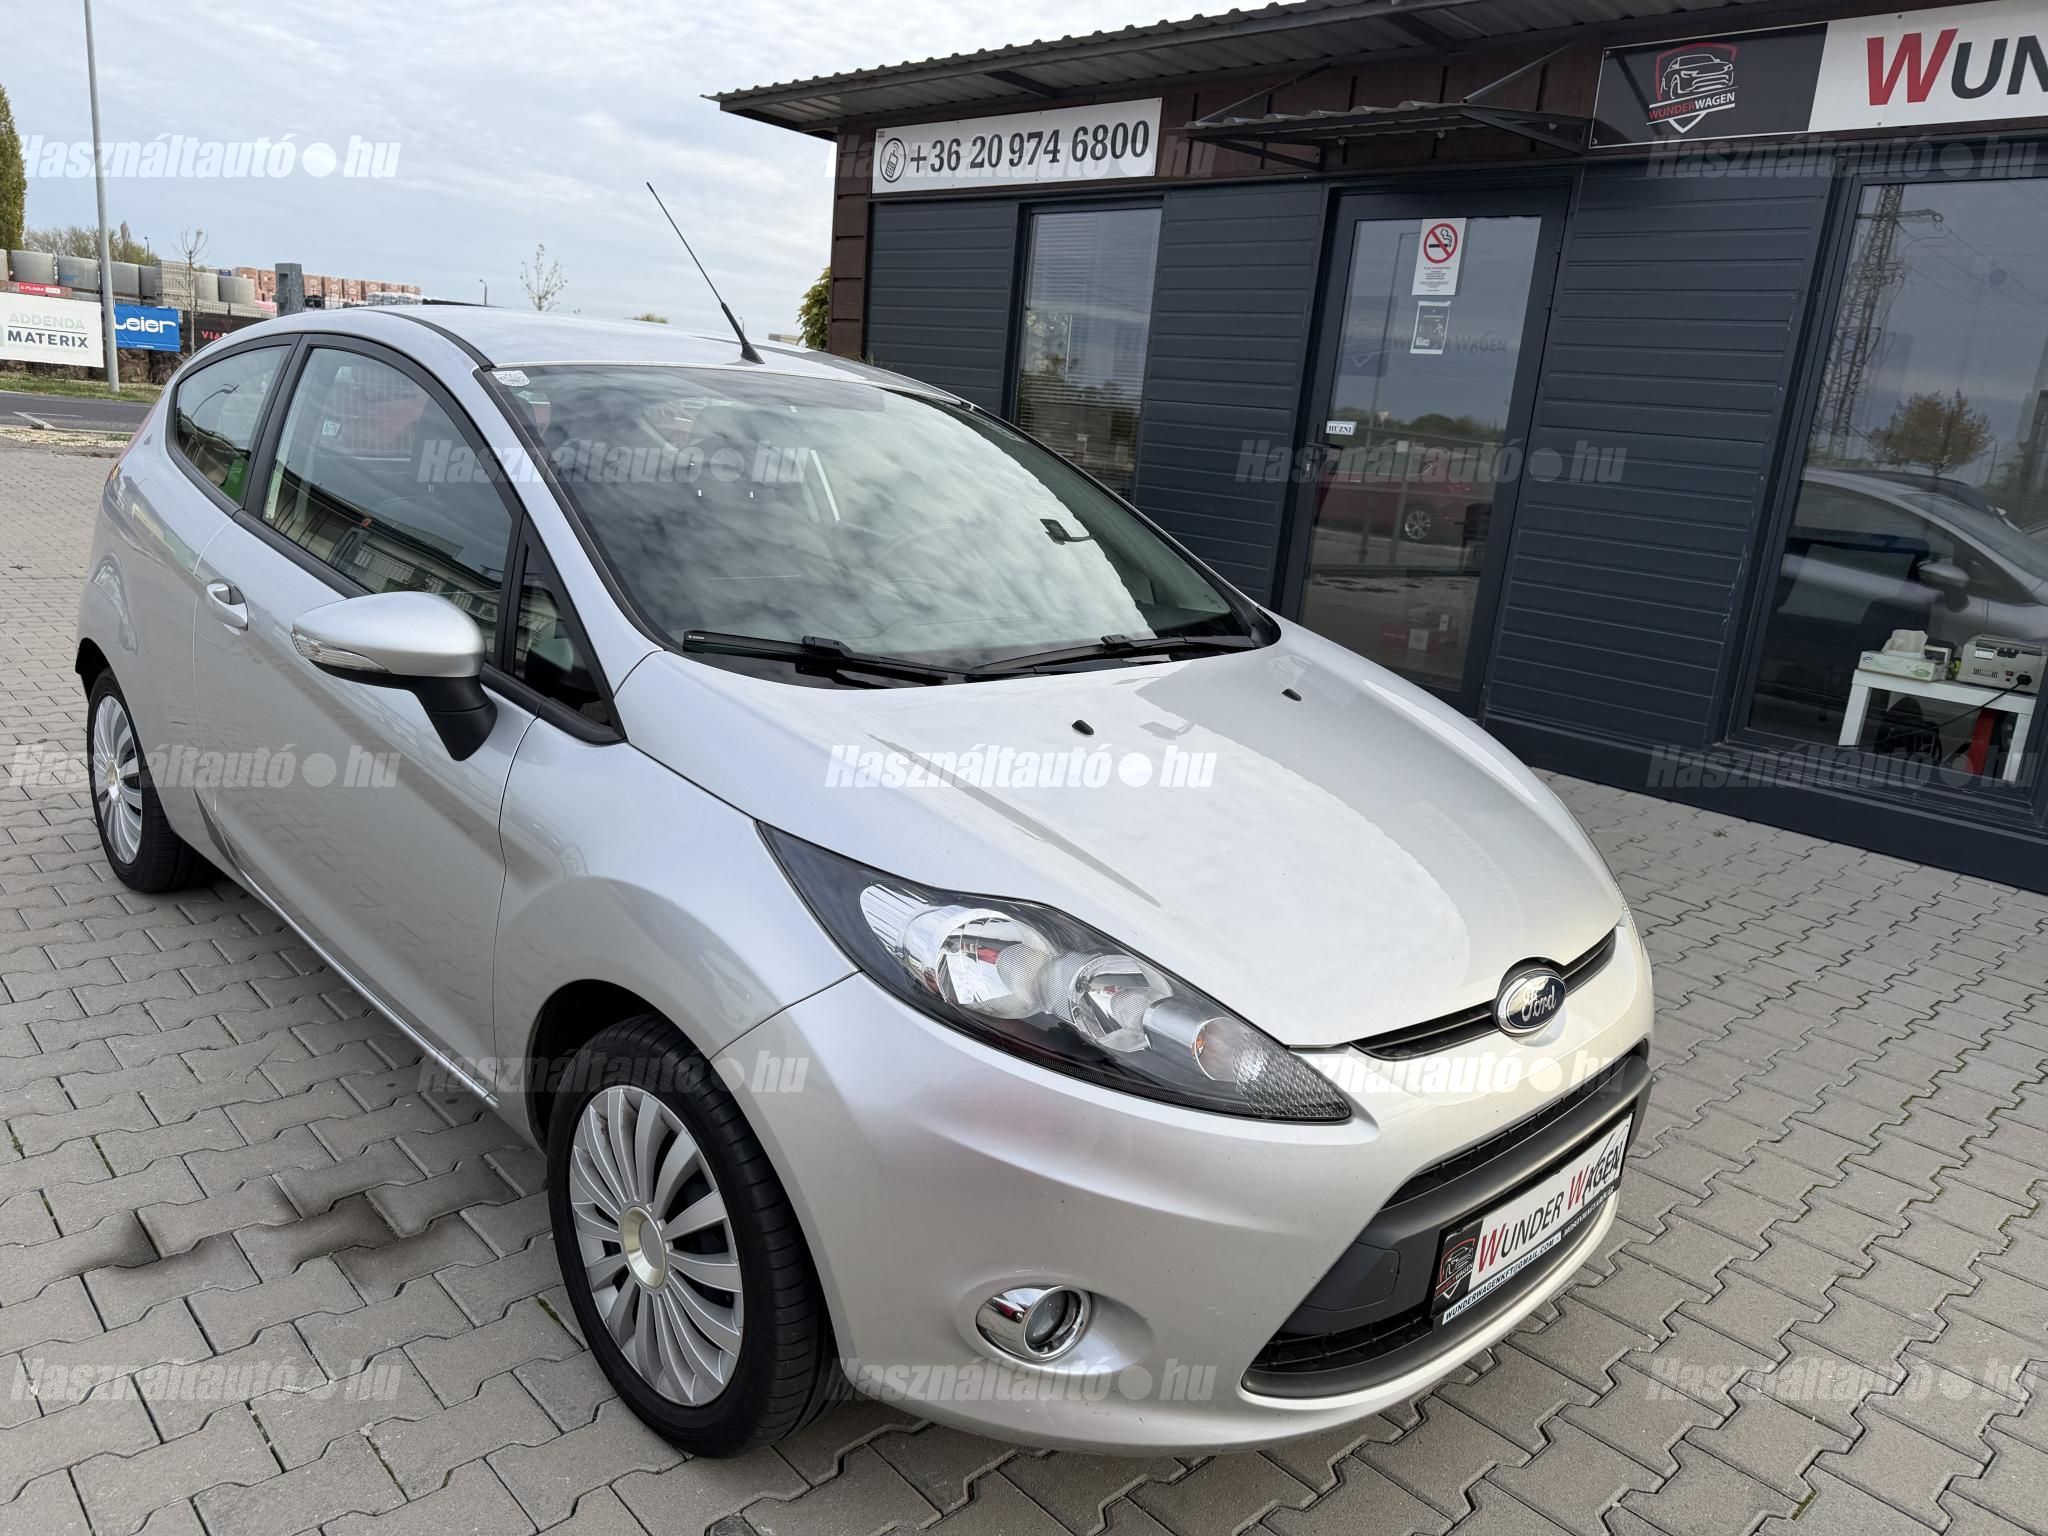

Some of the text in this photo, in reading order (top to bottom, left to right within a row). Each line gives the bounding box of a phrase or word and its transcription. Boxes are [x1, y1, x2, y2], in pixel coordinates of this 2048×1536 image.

[1649, 92, 1735, 120] WUNDERWAGEN
[910, 120, 1150, 173] +36 20 974 6800
[9, 312, 85, 330] ADDENDA
[8, 329, 88, 348] MATERIX
[1521, 985, 1557, 1022] Ford
[1478, 1191, 1564, 1273] WUNDER
[1568, 1140, 1624, 1211] WAGEN
